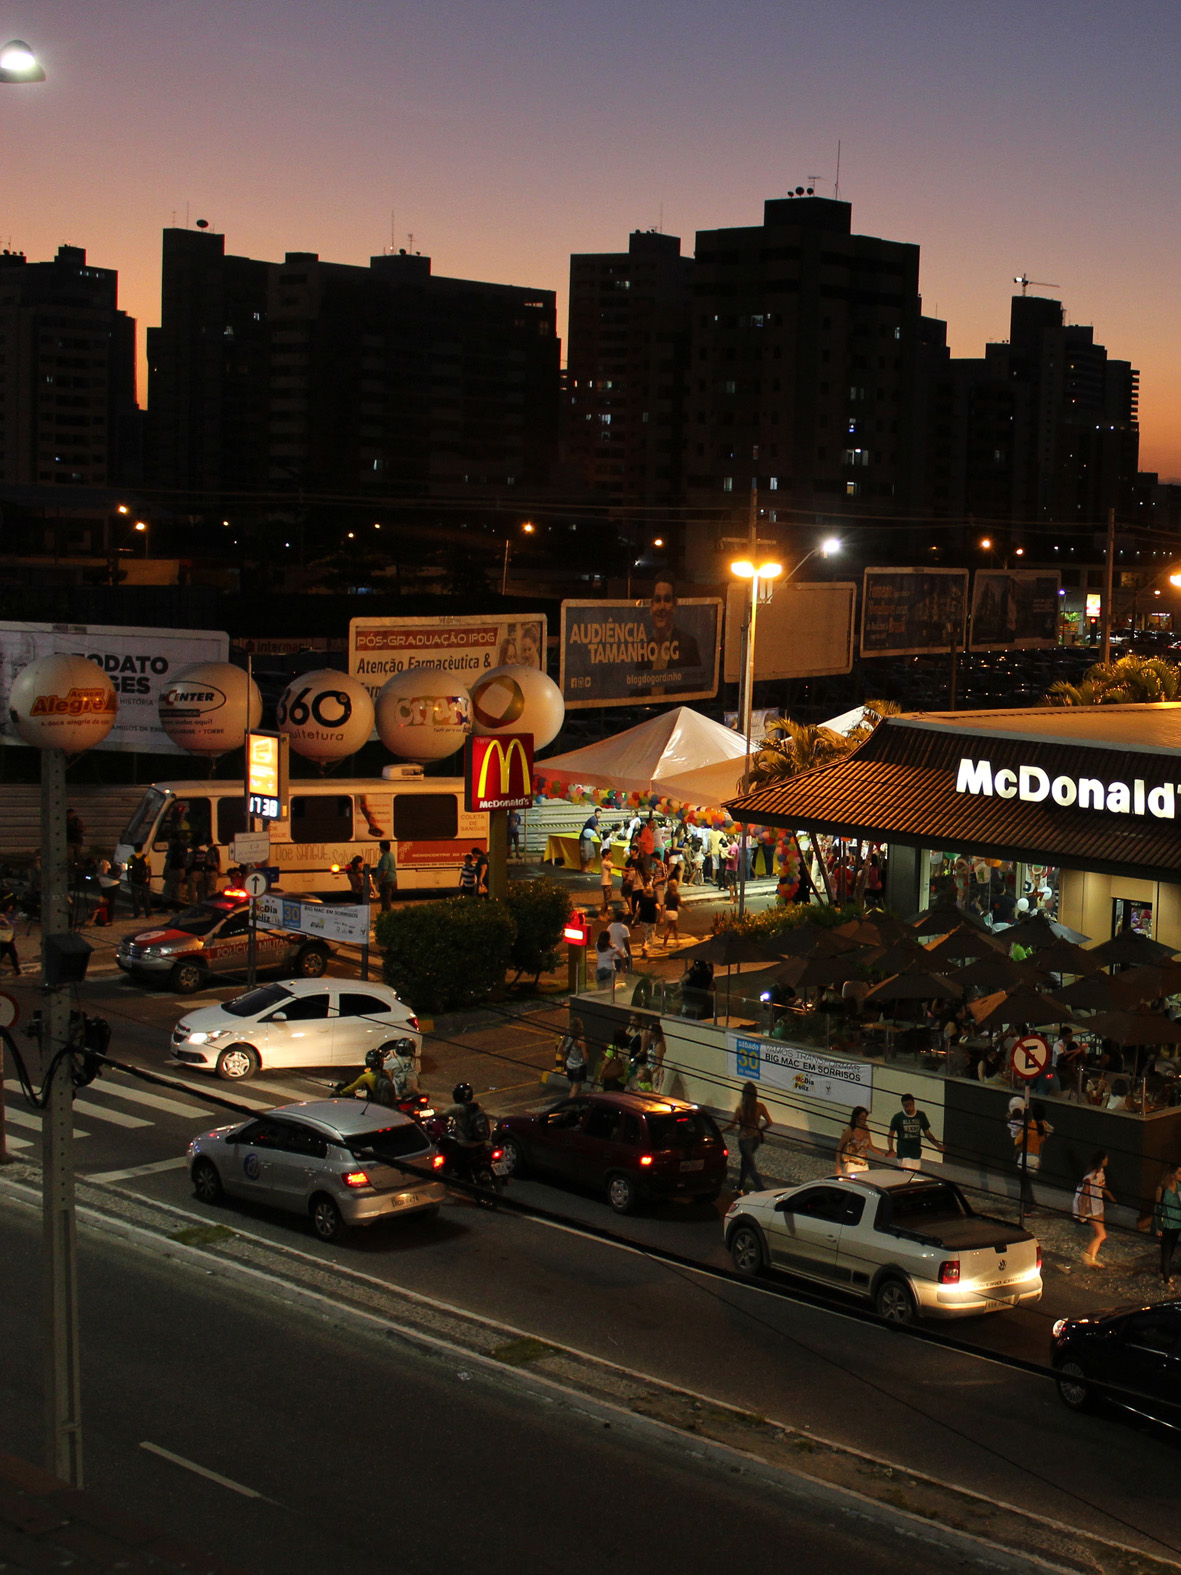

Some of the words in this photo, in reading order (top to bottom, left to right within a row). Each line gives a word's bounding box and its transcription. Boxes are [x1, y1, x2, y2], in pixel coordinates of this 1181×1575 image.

[570, 617, 647, 644] AUDIÊNCIA
[357, 632, 467, 647] PÓS-GRADUAÇÃO
[469, 632, 496, 643] IPOG
[587, 642, 658, 664] TAMANHO
[660, 640, 680, 660] GG
[357, 658, 404, 676] Atenção
[408, 654, 480, 671] Farmacêutica
[626, 672, 682, 687] blogdogordinho
[33, 697, 104, 714] Alegre
[119, 698, 154, 706] HISTÓRIA
[66, 719, 91, 727] alegria
[479, 797, 529, 809] McDonald's
[275, 845, 293, 861] Doe
[284, 906, 300, 921] 30
[259, 938, 289, 952] MILITAR
[765, 1045, 794, 1058] VAMOS
[738, 1049, 759, 1070] 30
[765, 1053, 779, 1062] BIG
[781, 1055, 800, 1068] MAC
[803, 1063, 816, 1072] EM
[818, 1066, 861, 1082] SORRISOS
